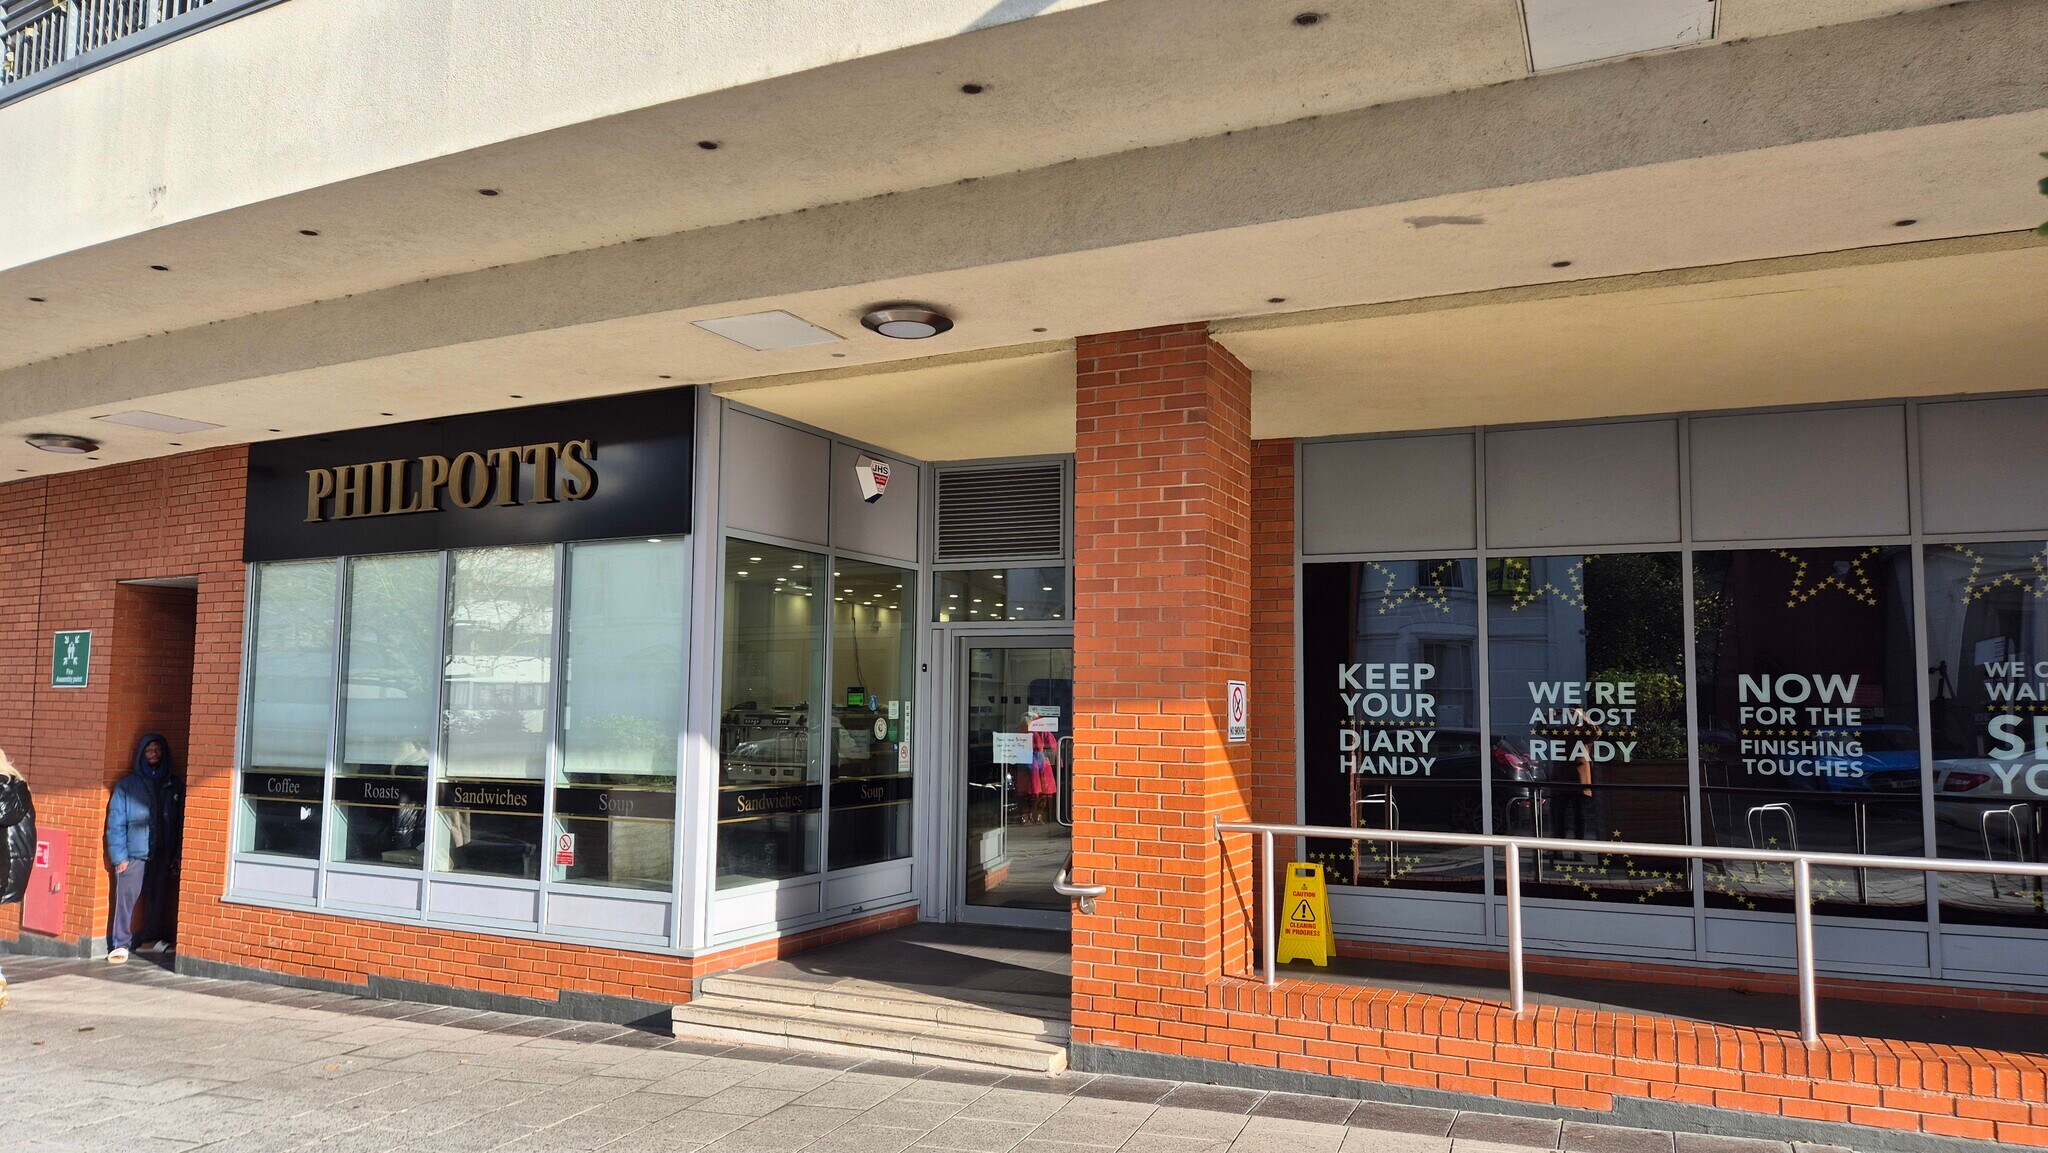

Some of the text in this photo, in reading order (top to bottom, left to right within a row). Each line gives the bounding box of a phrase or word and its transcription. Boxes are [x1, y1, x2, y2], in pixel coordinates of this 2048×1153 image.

[872, 464, 888, 474] JHS
[303, 439, 597, 521] PHILPOTTS
[1338, 662, 1436, 690] KEEP
[1983, 661, 2026, 678] WE
[73, 675, 83, 684] point
[1738, 673, 1860, 704] NOW
[1527, 681, 1637, 705] WE'RE
[1984, 682, 2048, 701] WAI
[1340, 692, 1436, 717] YOUR
[1529, 707, 1637, 726] ALMOST
[1740, 706, 1862, 726] FOR THE
[1339, 728, 1436, 753] DIARY
[1740, 739, 1863, 757] FINISHING
[1529, 739, 1638, 763] READY
[1340, 754, 1437, 776] HANDY
[1742, 758, 1864, 778] TOUCHES
[267, 778, 300, 794] Coffee
[364, 783, 400, 799] Roasts
[861, 784, 884, 801] Soup
[454, 787, 528, 806] Sandwiches
[599, 793, 634, 817] Soup
[737, 793, 803, 812] Sandwiches
[1292, 890, 1316, 898] CAUTION
[1290, 921, 1317, 929] CLEANING
[1292, 928, 1321, 937] PROGRESS
